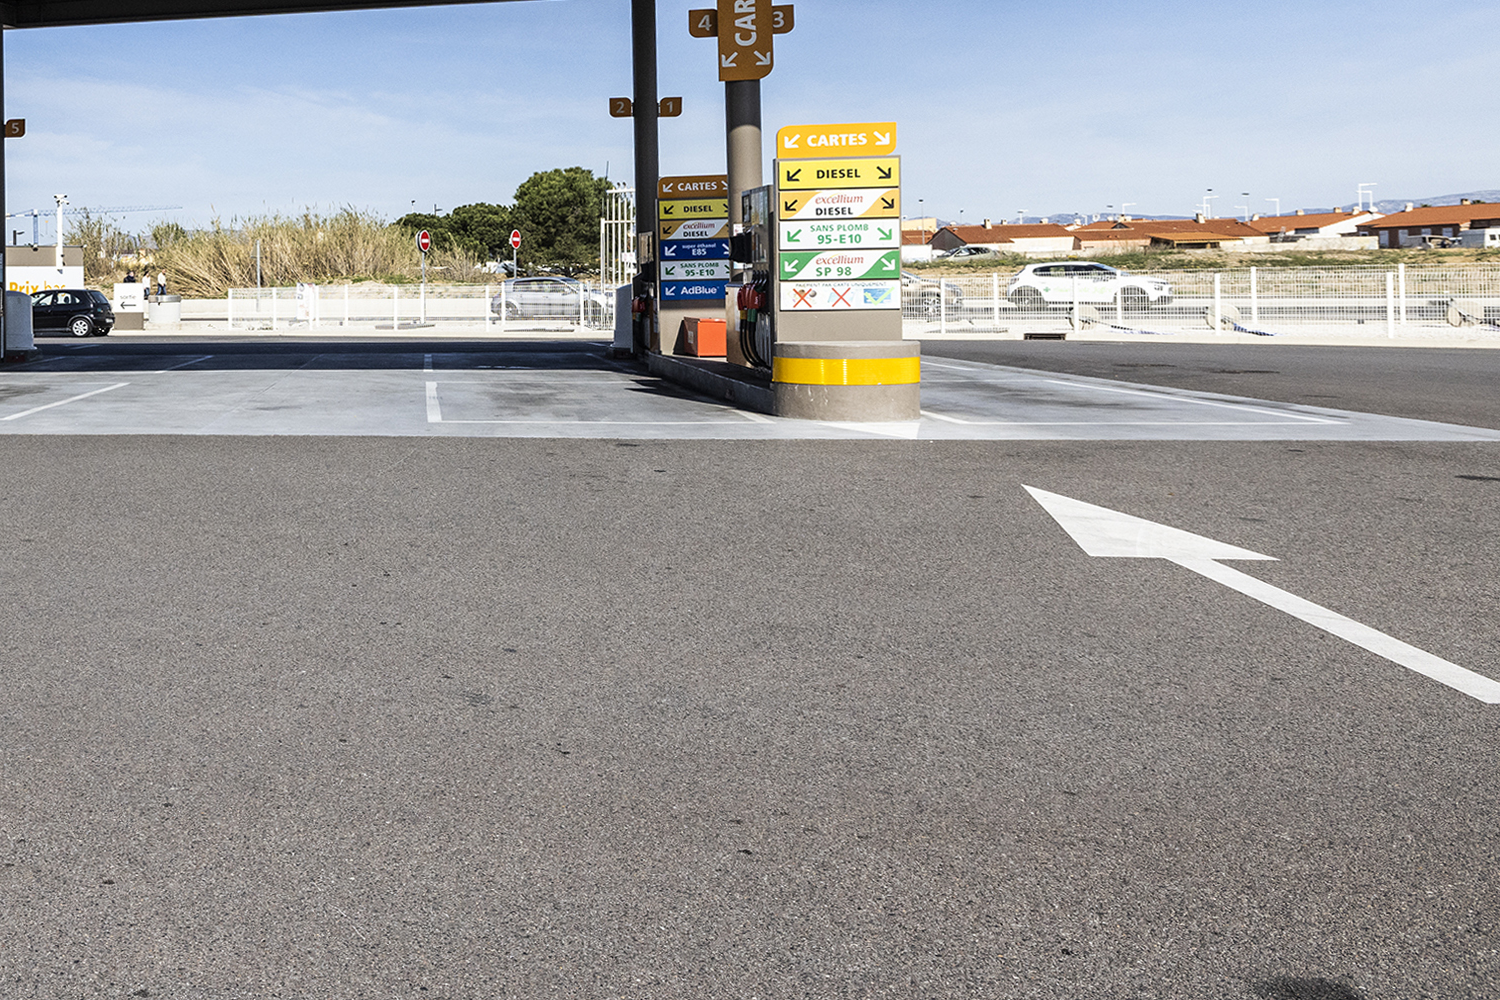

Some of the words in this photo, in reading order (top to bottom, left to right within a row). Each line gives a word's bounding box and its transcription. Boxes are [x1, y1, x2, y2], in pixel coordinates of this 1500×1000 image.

[698, 15, 712, 31] 4
[772, 11, 785, 28] 3
[616, 101, 625, 113] 2
[666, 101, 673, 113] 1
[11, 122, 20, 134] 5
[806, 133, 868, 147] CARTES
[816, 168, 861, 179] DIESEL
[677, 181, 718, 192] CARTES
[815, 194, 863, 205] excellium
[683, 205, 713, 213] DIESEL
[815, 207, 853, 216] DIESEL
[810, 224, 835, 232] SANS
[836, 224, 869, 232] PLOMB
[692, 248, 707, 256] E85
[815, 254, 864, 265] excellium
[815, 266, 832, 277] SP
[837, 266, 852, 276] 98
